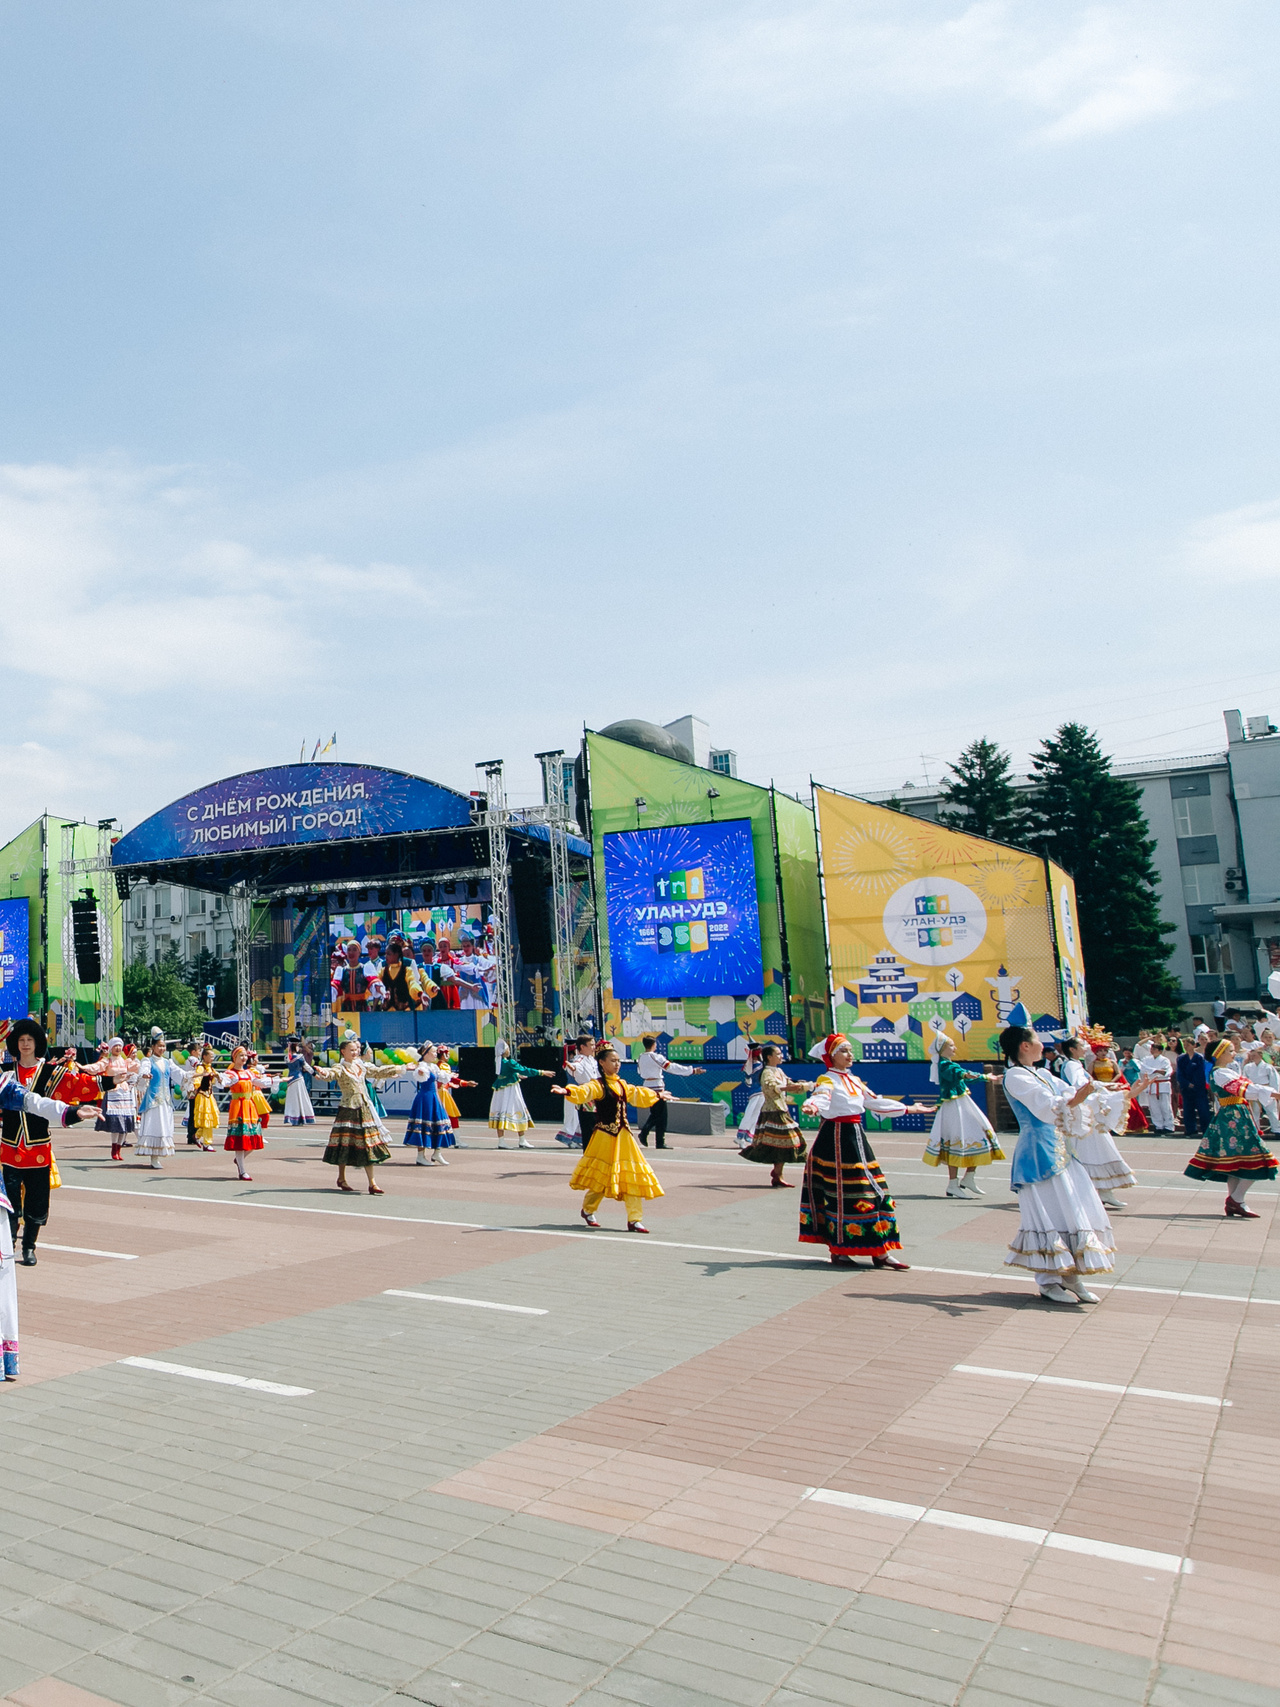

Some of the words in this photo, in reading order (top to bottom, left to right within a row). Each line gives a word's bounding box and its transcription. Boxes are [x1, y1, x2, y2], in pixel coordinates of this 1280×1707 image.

[187, 806, 198, 821] С
[201, 798, 251, 821] ДНЁМ
[256, 783, 370, 812] РОЖДЕНИЯ,
[192, 815, 287, 844] ЛЮБИМЫЙ
[292, 809, 362, 831] ГОРОД!
[635, 901, 728, 921] УЛАН-УДЭ
[902, 915, 966, 927] УЛАН-УДЭ
[709, 924, 729, 932] 2022
